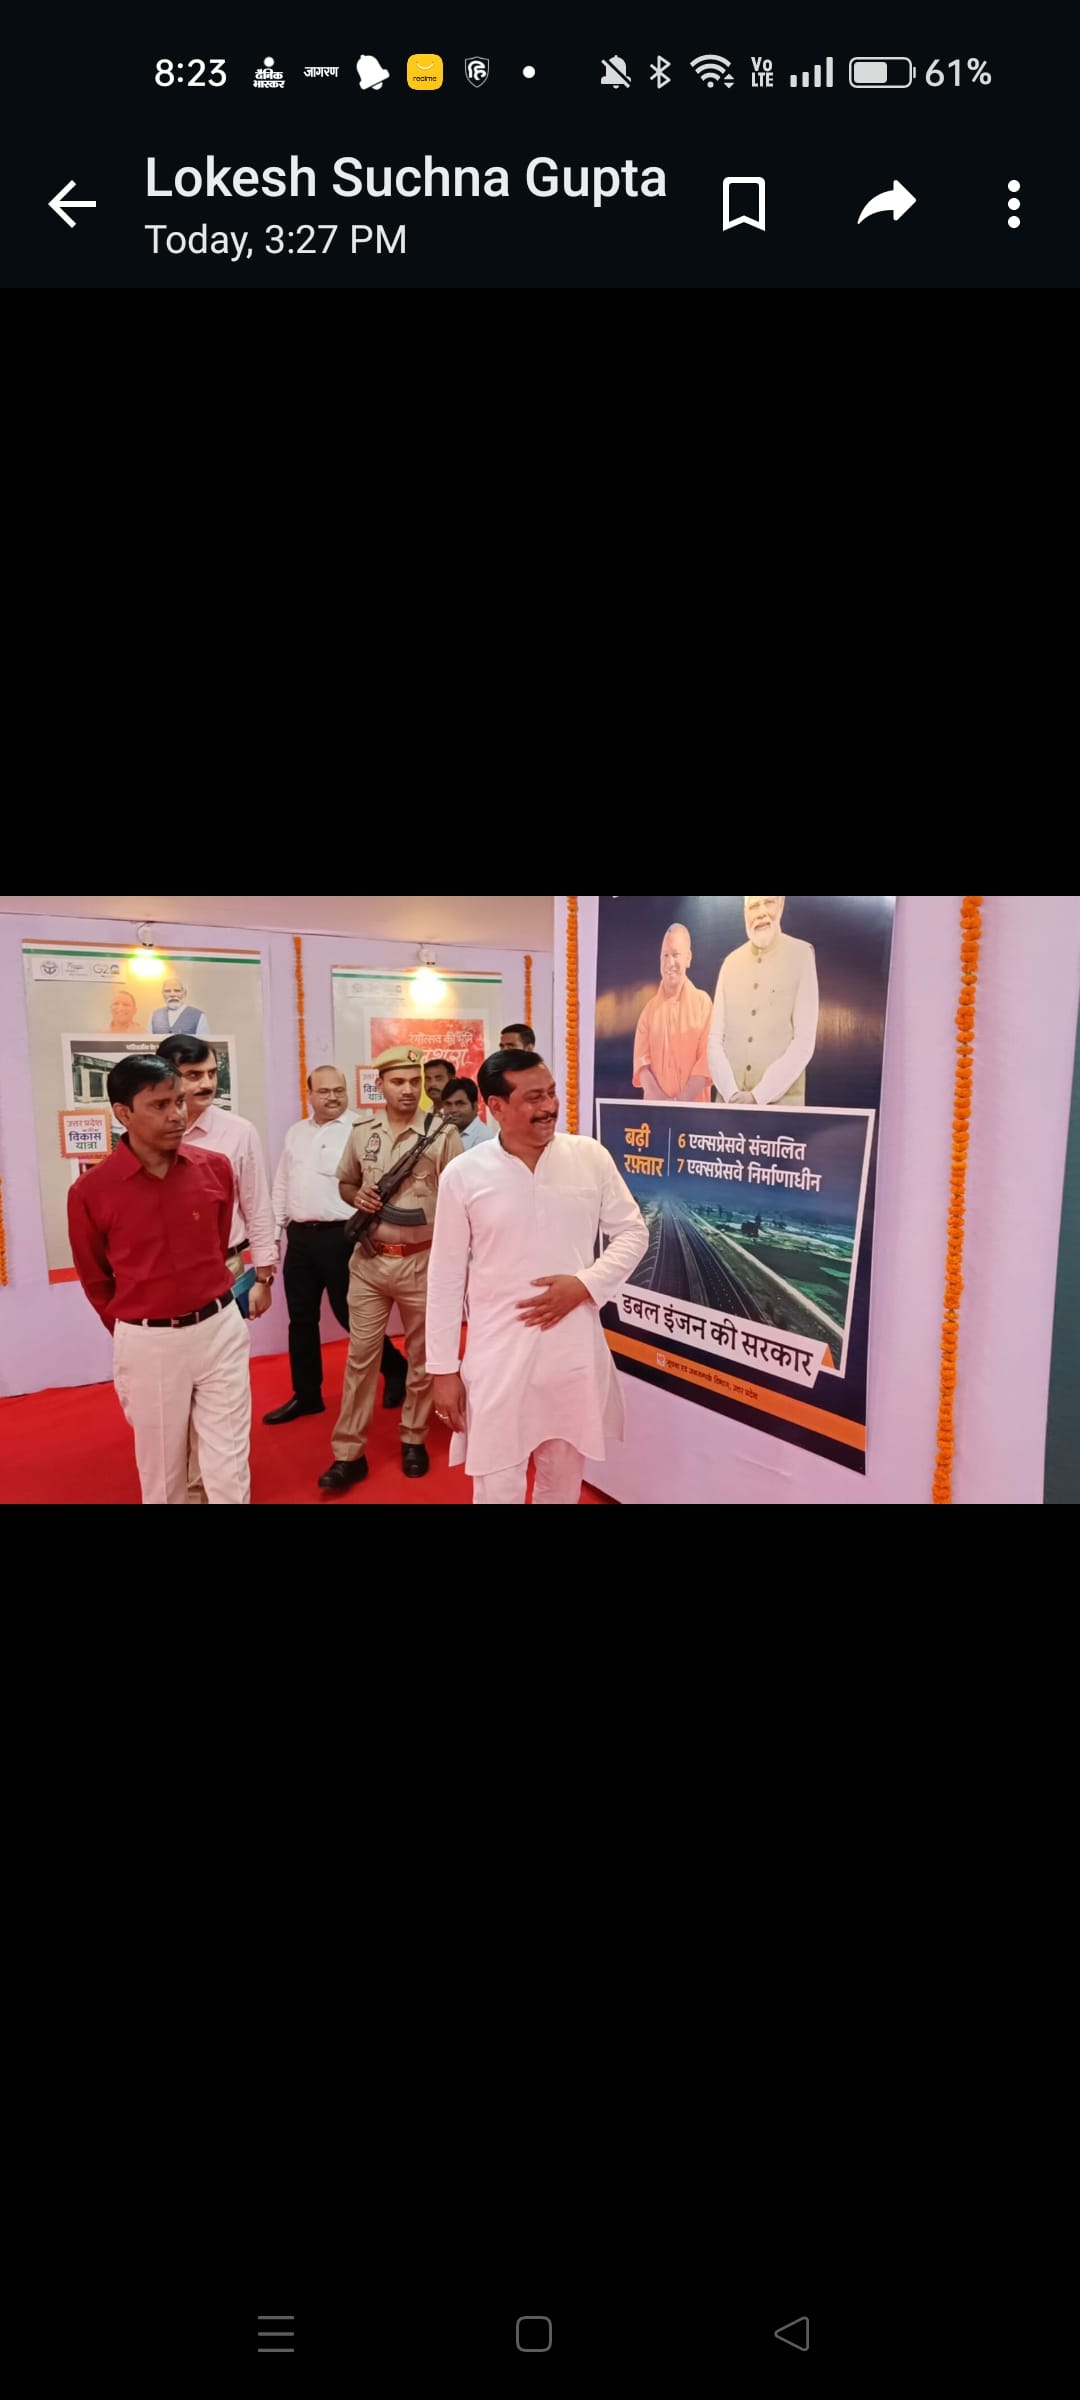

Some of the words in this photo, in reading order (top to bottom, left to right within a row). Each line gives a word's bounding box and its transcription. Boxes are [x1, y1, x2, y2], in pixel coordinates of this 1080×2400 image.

[69, 1130, 102, 1141] विकास
[624, 1122, 651, 1152] बढ़ी
[678, 1133, 686, 1149] 6
[688, 1131, 745, 1155] एक्सप्रेसवे
[748, 1135, 807, 1161] संचालित
[624, 1154, 664, 1177] रफ़्तार
[677, 1158, 685, 1173] 7
[687, 1157, 745, 1182] एक्सप्रेसवे
[747, 1160, 822, 1192] निर्माणाधीन
[621, 1293, 660, 1324] डबल
[663, 1304, 707, 1340] इंजन
[710, 1318, 738, 1350] की
[741, 1331, 814, 1376] सरकार
